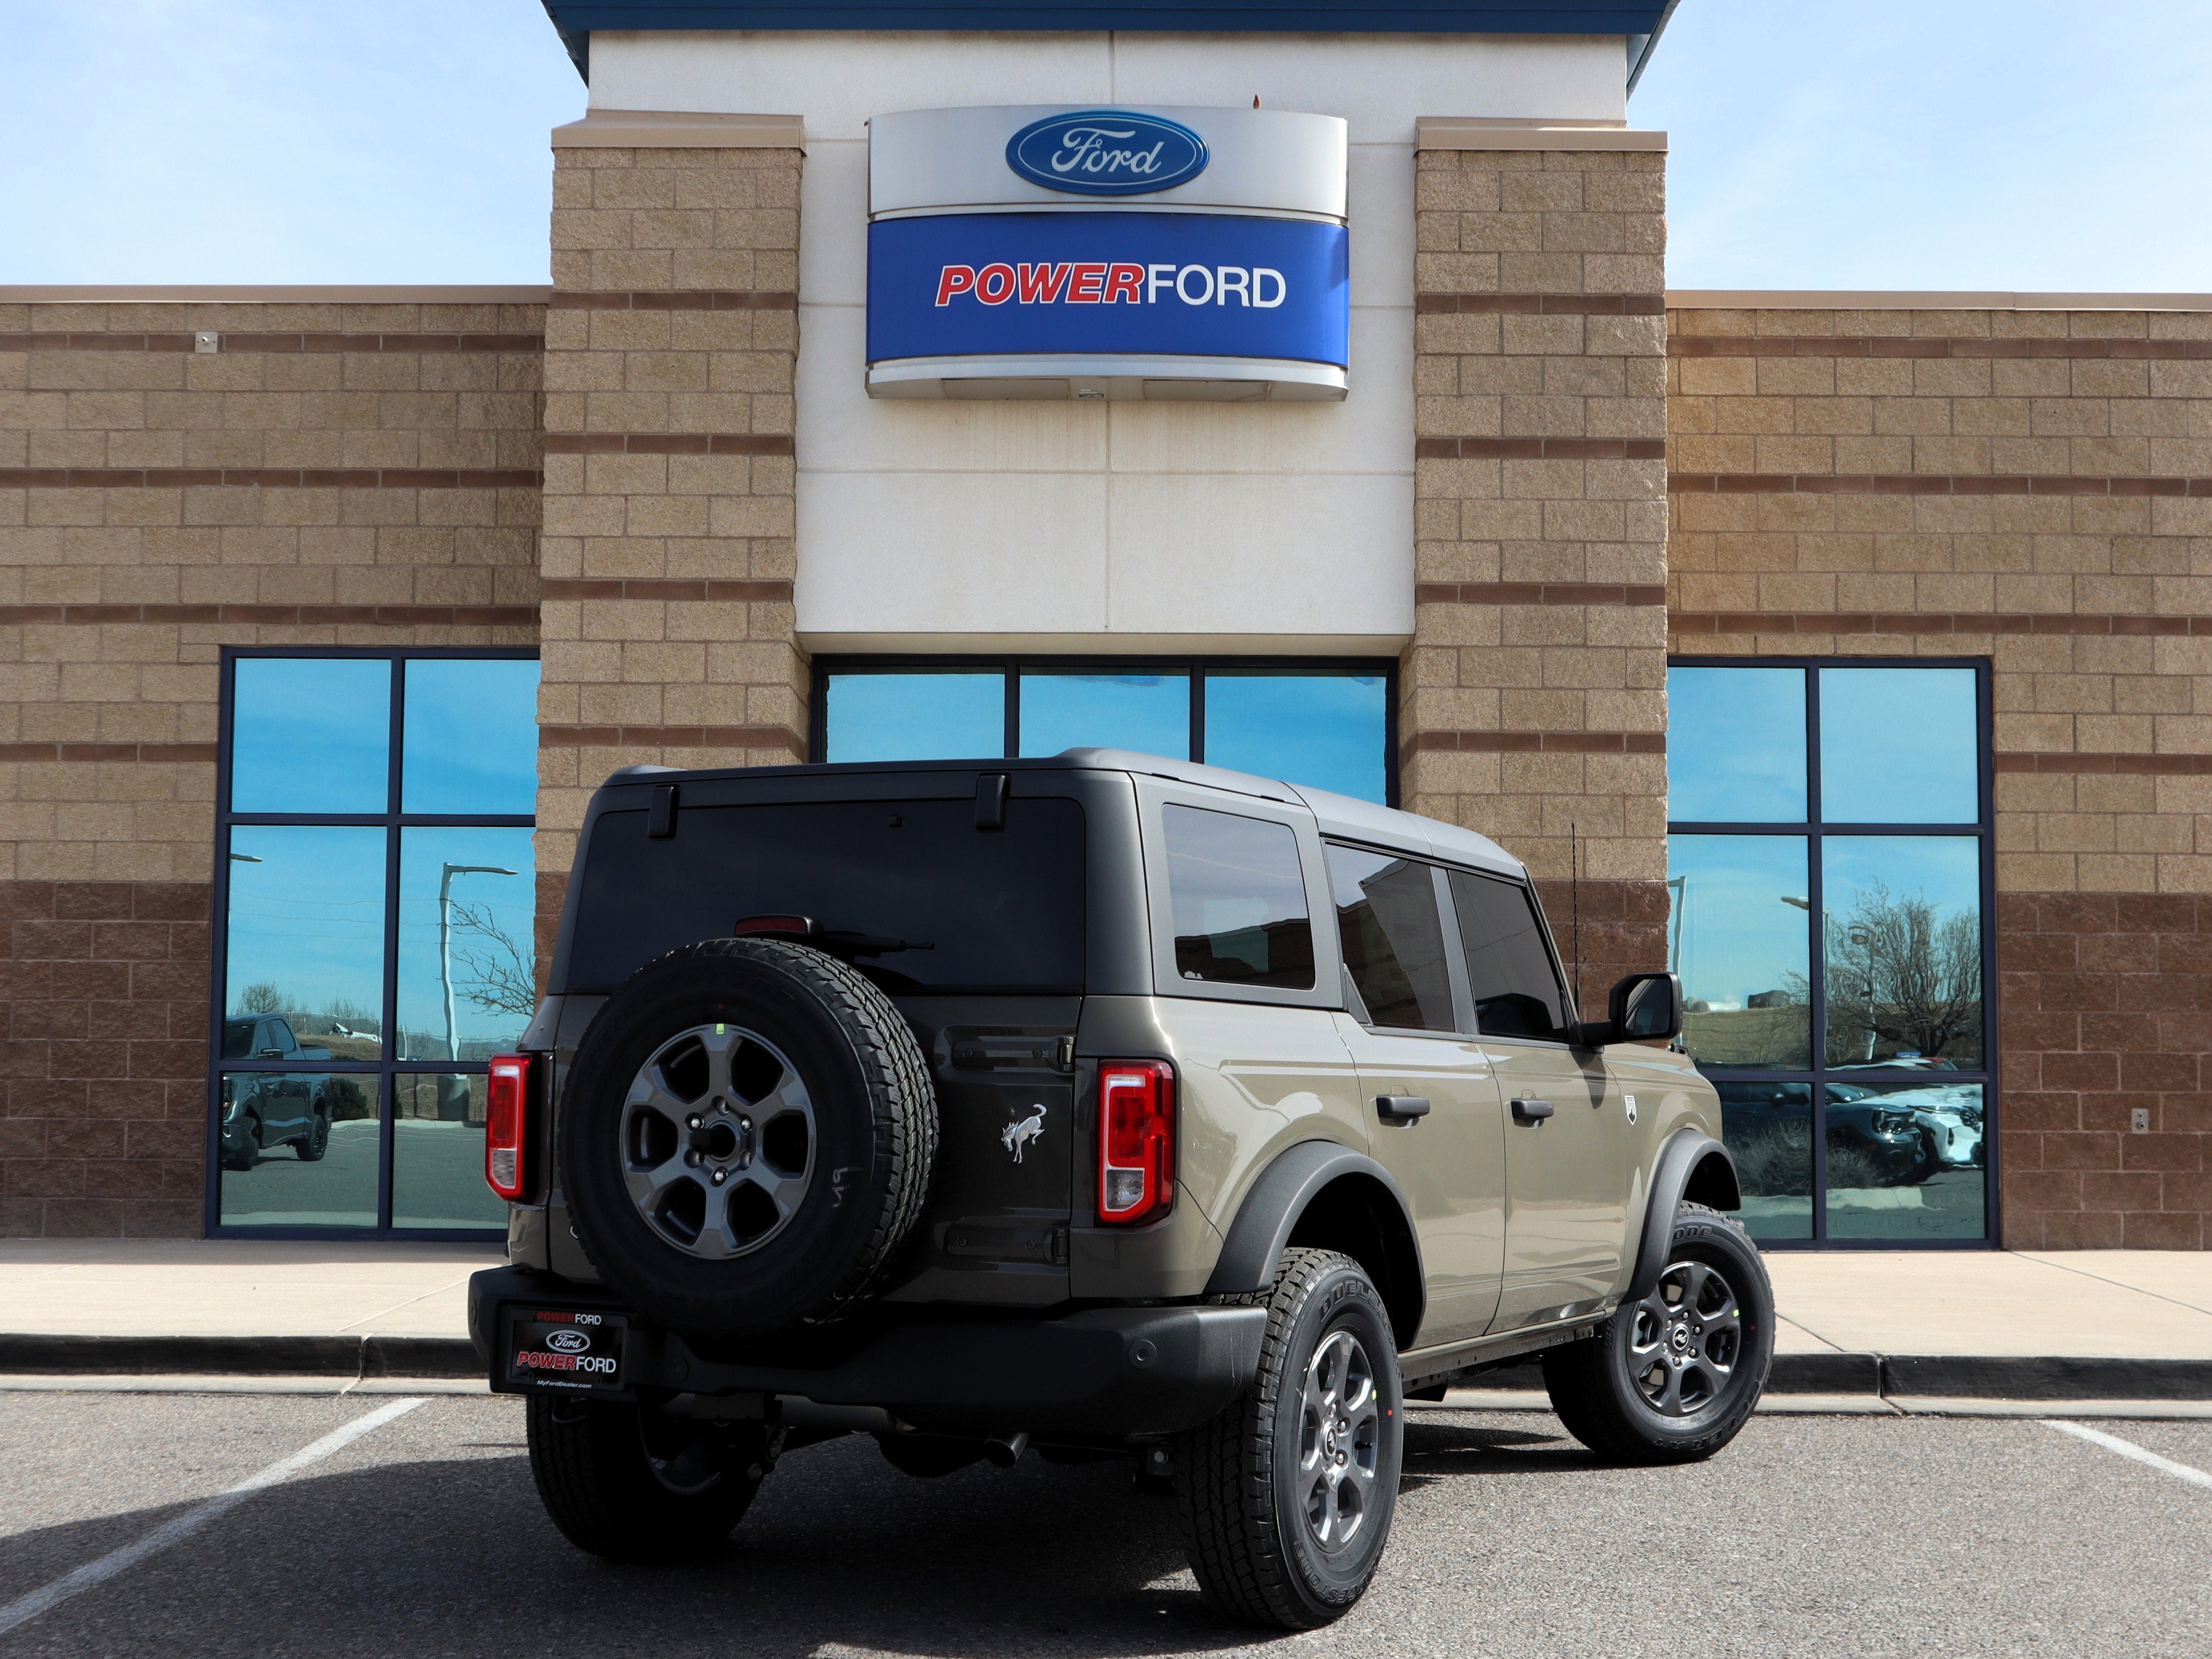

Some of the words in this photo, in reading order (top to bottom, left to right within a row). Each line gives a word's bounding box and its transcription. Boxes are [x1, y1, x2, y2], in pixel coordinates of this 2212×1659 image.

[1051, 127, 1166, 174] Ford
[555, 1333, 581, 1349] Ford
[537, 1379, 592, 1389] MyFordDealer.com
